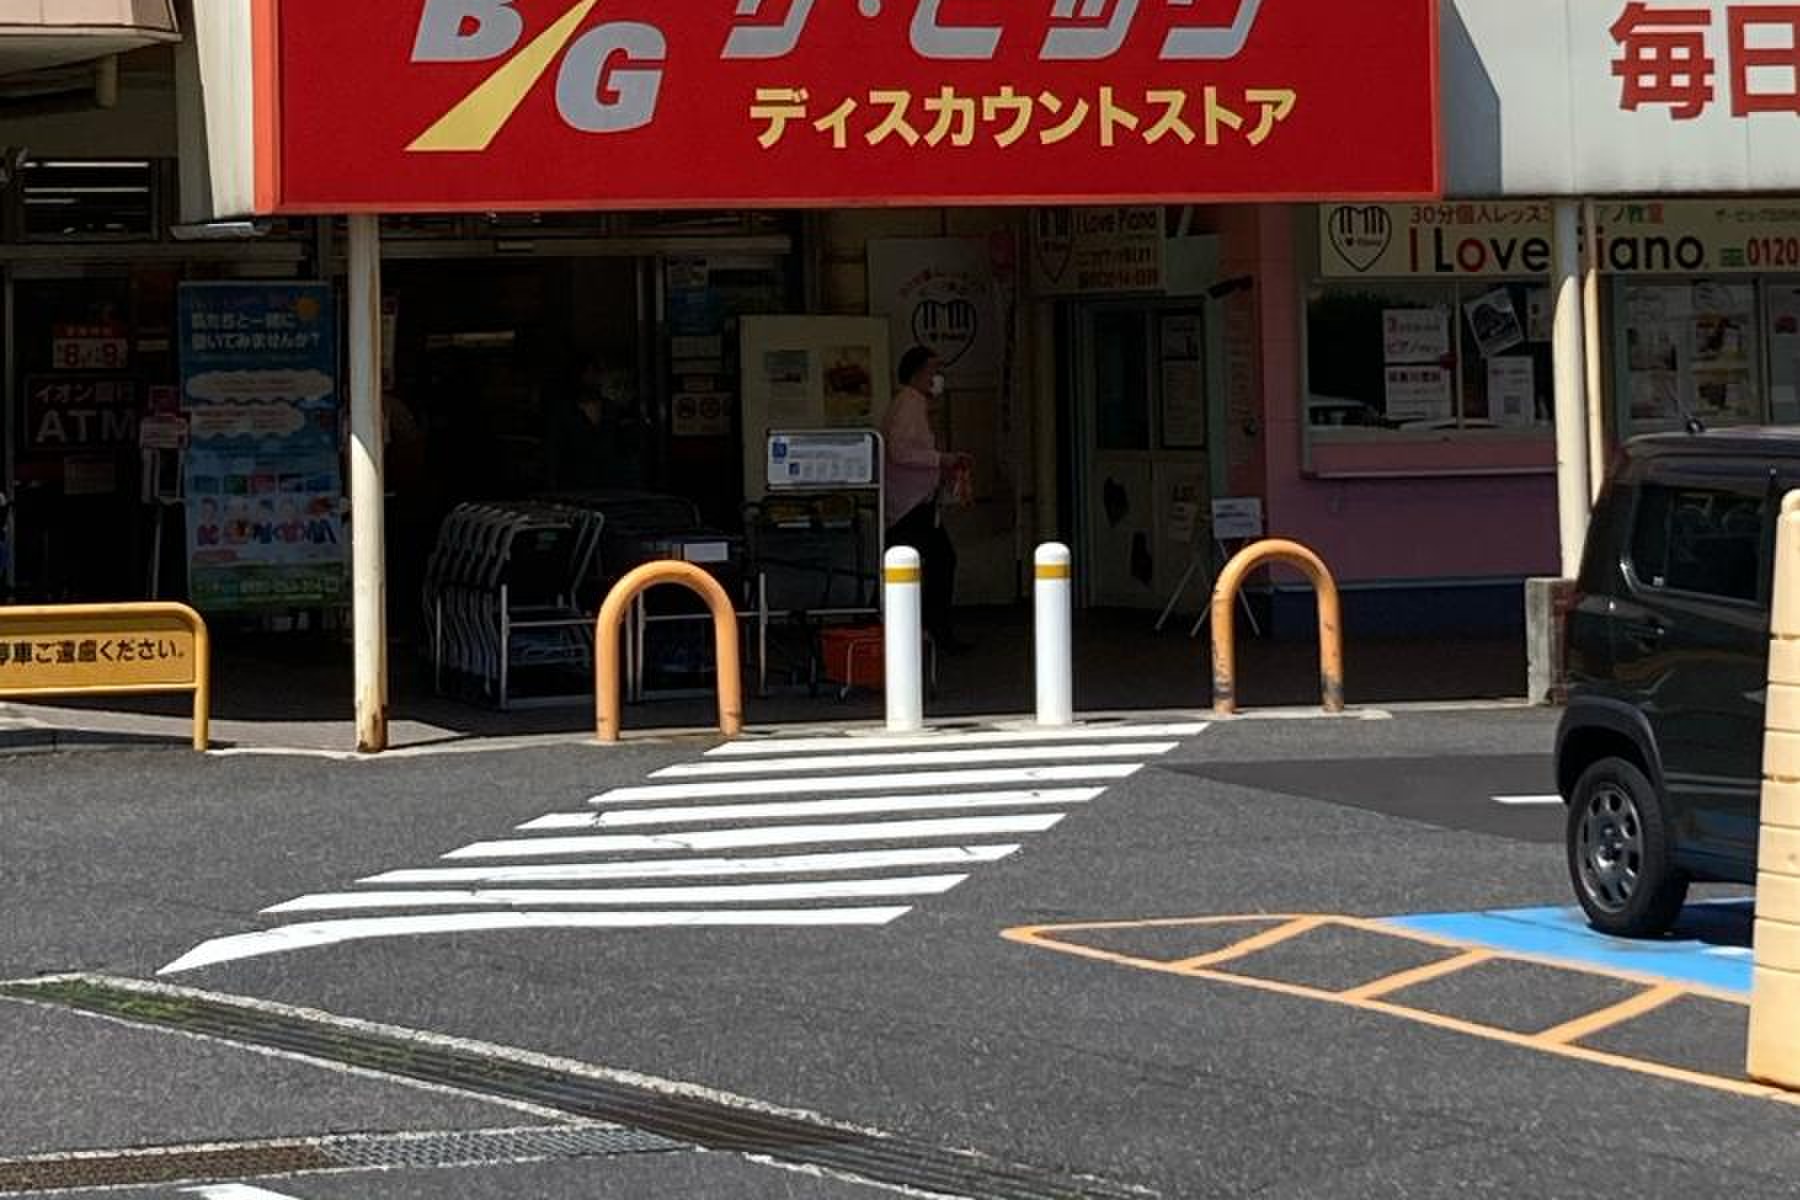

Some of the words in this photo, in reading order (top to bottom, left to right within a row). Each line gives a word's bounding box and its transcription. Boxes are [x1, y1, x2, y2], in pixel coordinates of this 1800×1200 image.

[1609, 1, 1800, 121] 毎日
[749, 86, 1297, 150] ディスカウントストア
[1434, 227, 1550, 273] Love
[1577, 226, 1704, 270] iano
[34, 383, 137, 404] イオン
[34, 408, 138, 443] ATM
